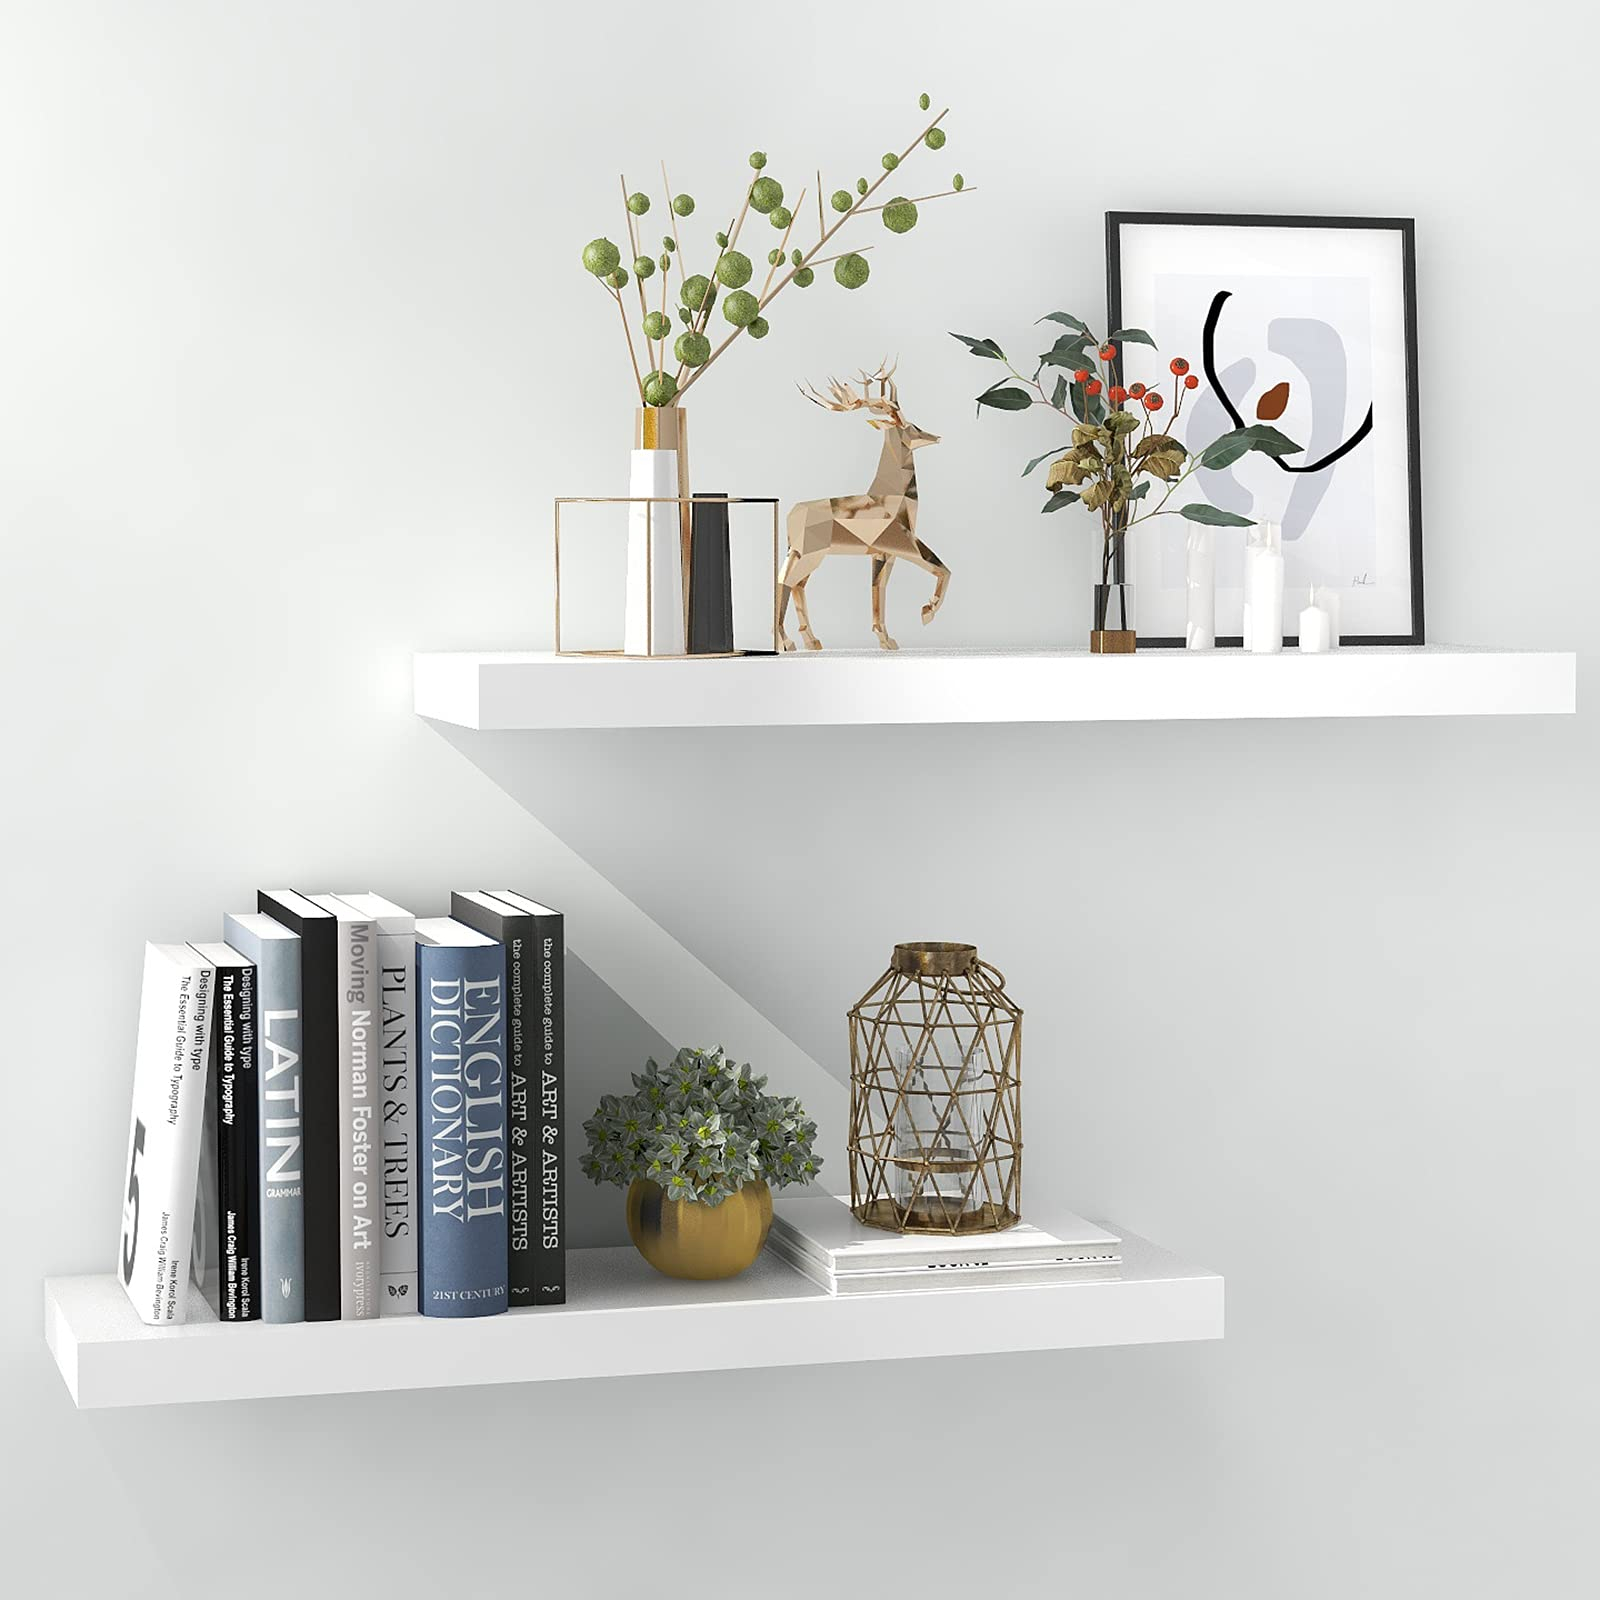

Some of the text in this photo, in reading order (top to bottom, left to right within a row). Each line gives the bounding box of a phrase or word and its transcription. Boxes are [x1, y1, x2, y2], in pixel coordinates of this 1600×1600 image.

[166, 976, 191, 1125] The Essential Guide to Typography
[191, 970, 210, 1071] Designing with type
[222, 975, 235, 1125] The Essential Guide to Typography
[239, 968, 252, 1069] Designing with type
[346, 924, 372, 1249] Moving Norman Foster on Art
[264, 1010, 300, 1182] LATIN
[382, 965, 409, 1238] PLANTS & TREES
[431, 978, 464, 1223] DICTIONARY
[463, 975, 504, 1222] ENGLISH
[511, 939, 528, 1251] the complete guide to ART & ARTISTS
[542, 938, 559, 1249] the complete guide to ART & ARTISTS
[123, 1117, 146, 1286] 5
[153, 1212, 170, 1320] James Craig William Bevington
[226, 1211, 237, 1319] James Craig William Bevington
[267, 1187, 301, 1198] GRAMMAR
[166, 1260, 179, 1320] Irene Korol Scala
[241, 1258, 250, 1318] Irene Korol Scala
[353, 1261, 364, 1317] ivorypress
[432, 1285, 506, 1300] 21ST CENTURY
